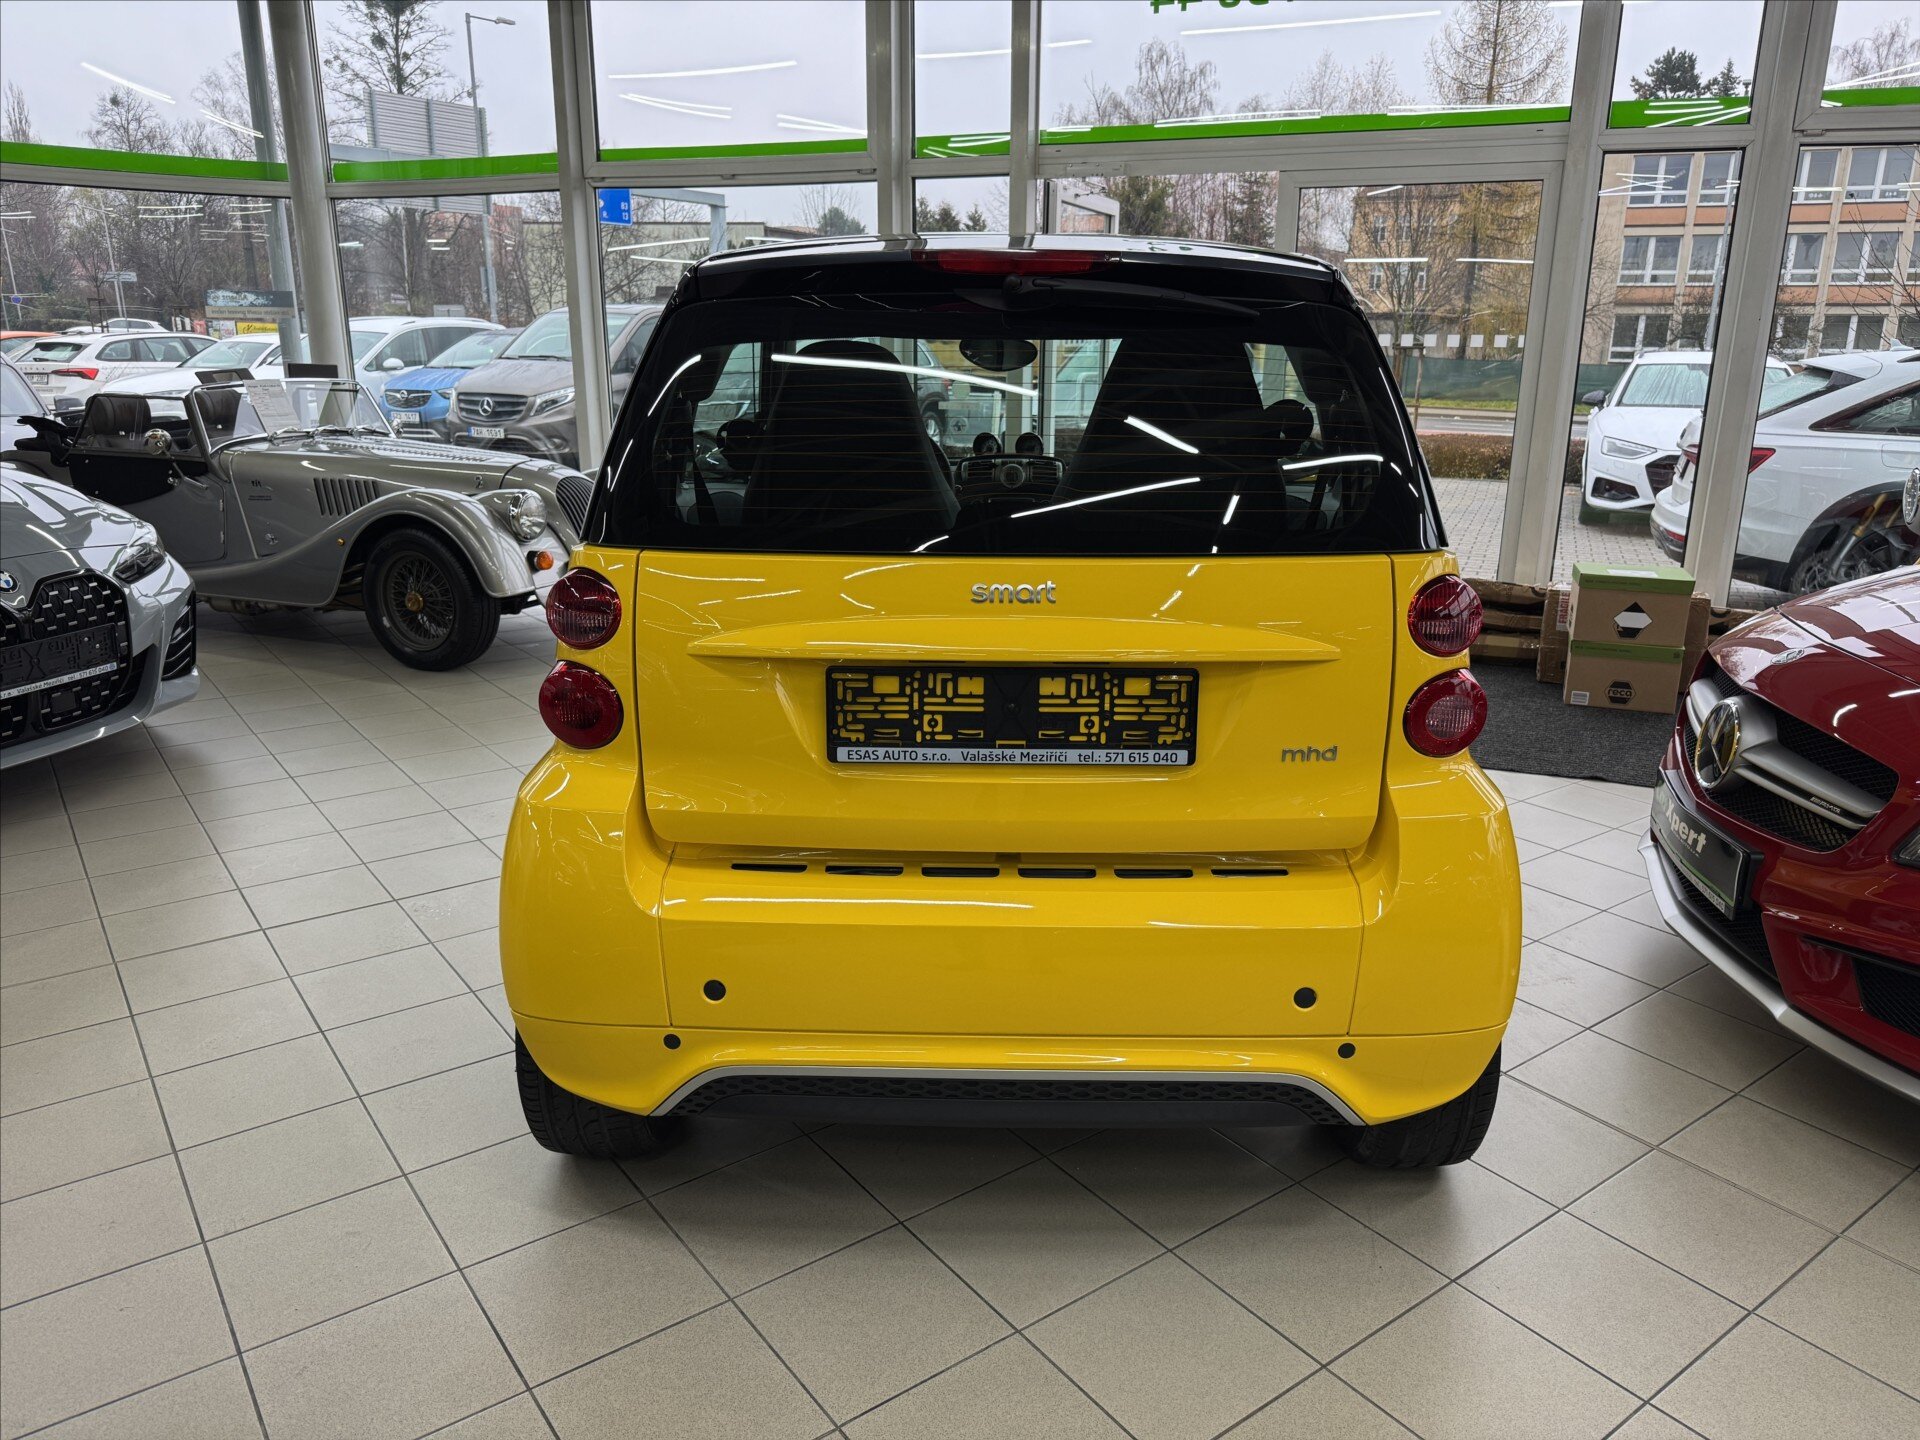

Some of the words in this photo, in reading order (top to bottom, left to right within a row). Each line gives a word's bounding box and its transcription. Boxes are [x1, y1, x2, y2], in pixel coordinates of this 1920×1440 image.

[970, 580, 1056, 603] smart
[1607, 688, 1632, 697] reca
[847, 749, 879, 761] ESAS
[882, 750, 919, 761] AUTO
[922, 752, 951, 762] s.r.o.
[961, 750, 1017, 762] Valašské
[1020, 751, 1067, 763] Meziříčí
[1078, 752, 1101, 763] tel.:
[1105, 752, 1125, 763] 571
[1128, 752, 1149, 763] 615
[1153, 752, 1178, 763] 040
[1281, 745, 1338, 762] mhd
